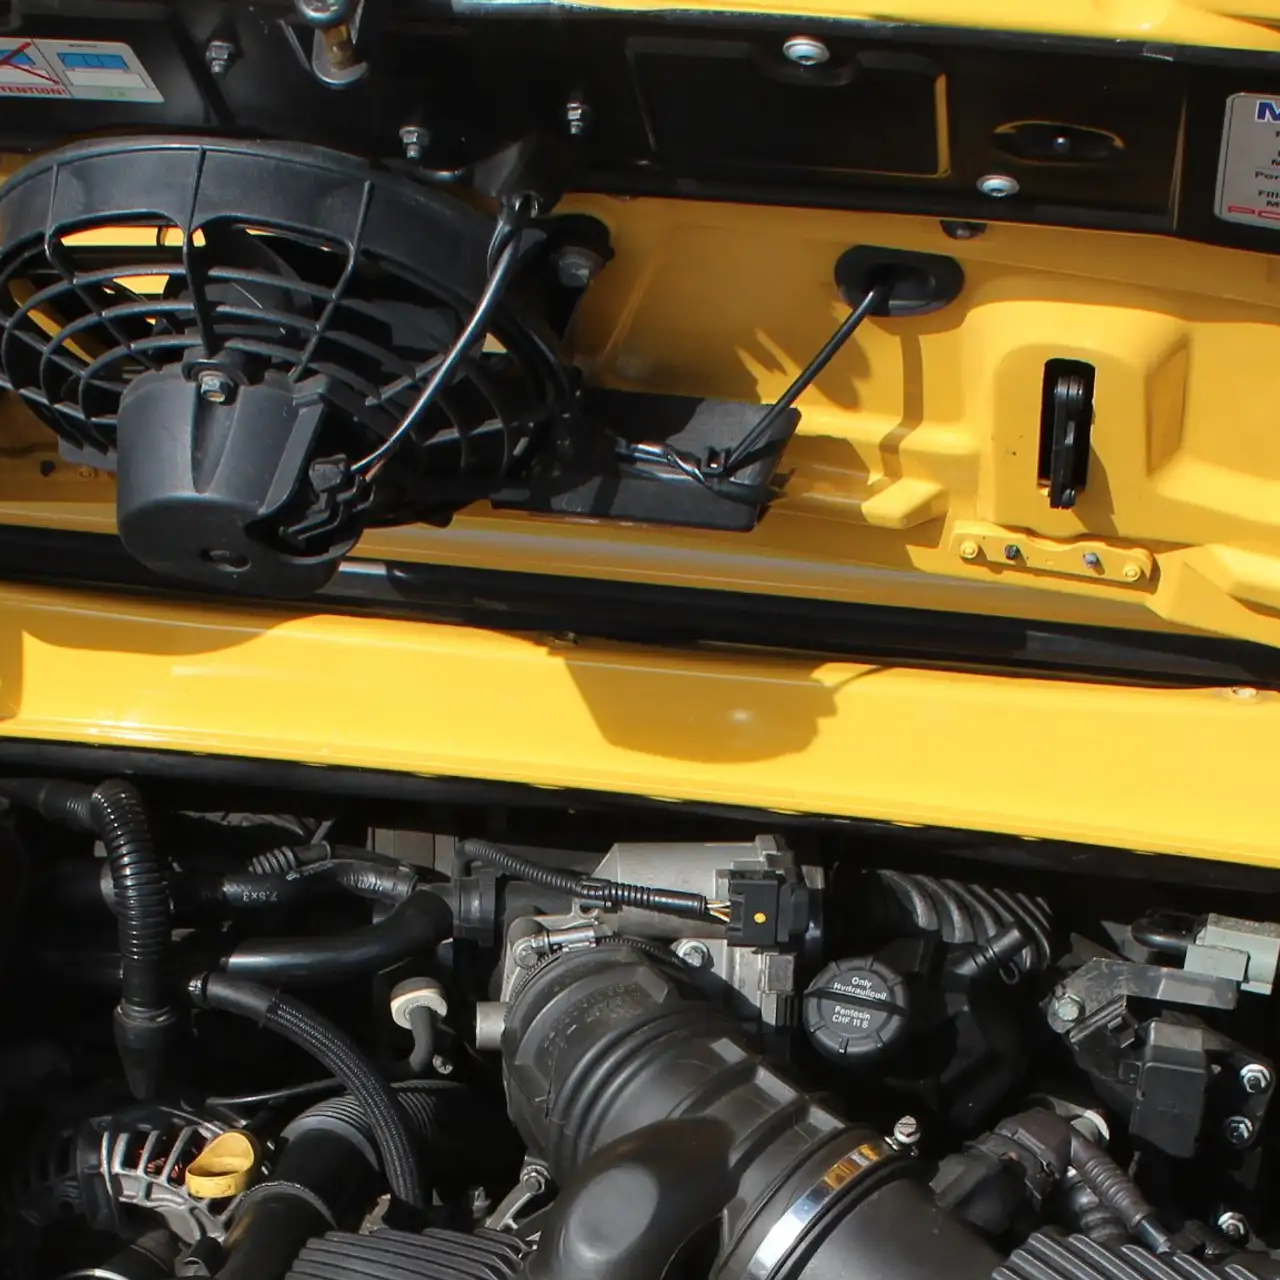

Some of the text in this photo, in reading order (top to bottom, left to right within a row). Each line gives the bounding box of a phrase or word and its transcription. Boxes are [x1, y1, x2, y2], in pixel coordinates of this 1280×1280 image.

[851, 976, 872, 988] Only
[834, 1005, 871, 1020] Pentosin
[832, 1014, 851, 1025] CHF
